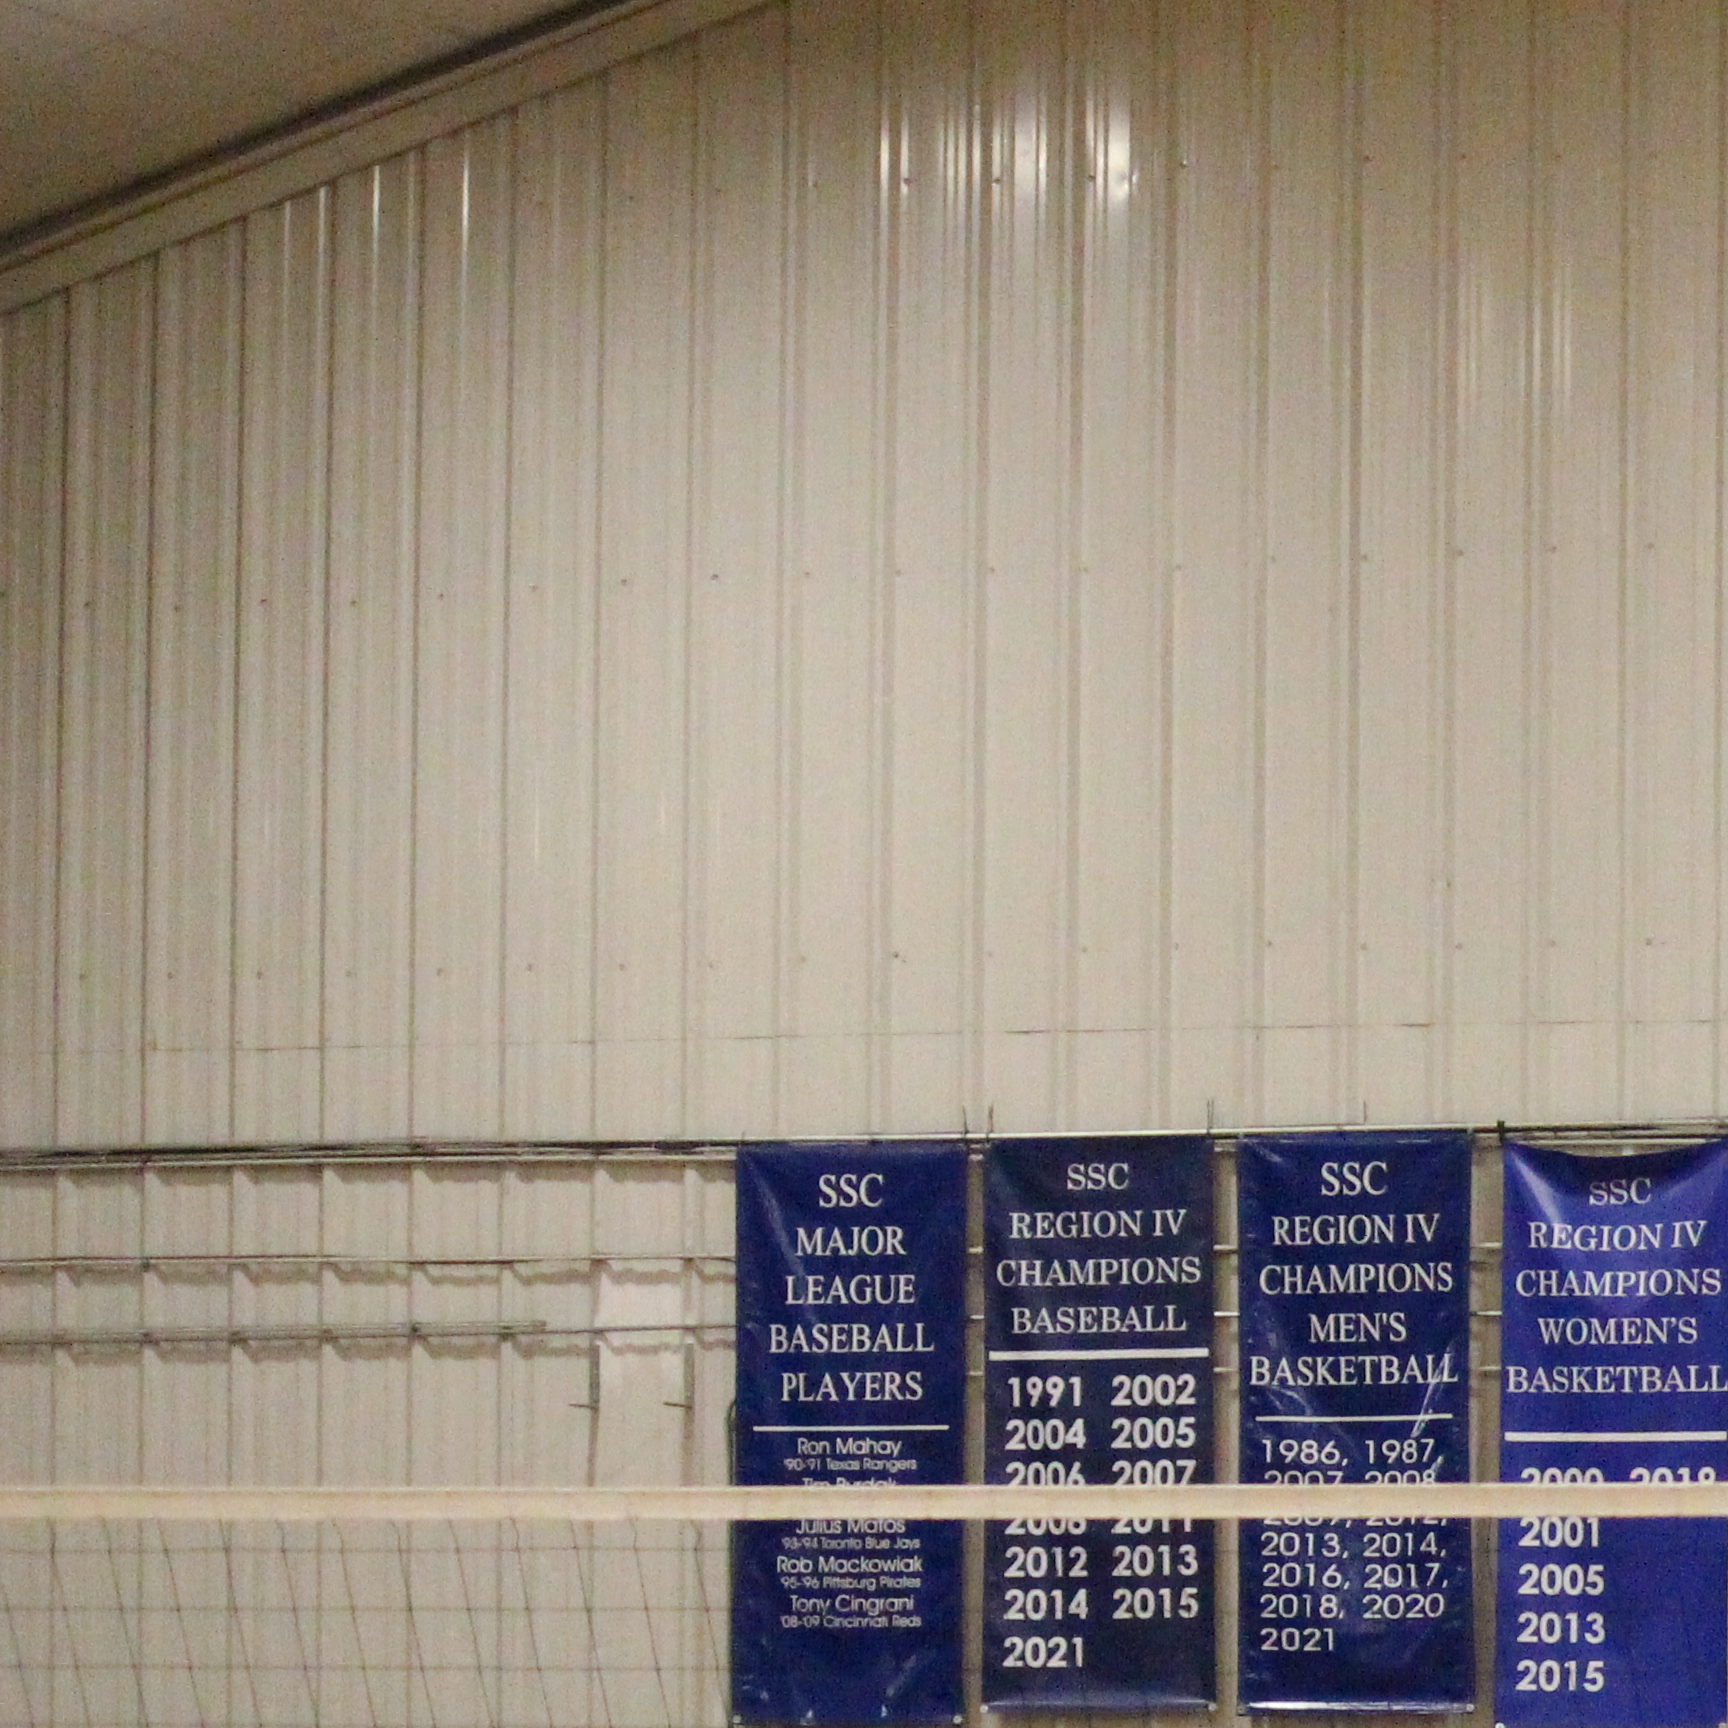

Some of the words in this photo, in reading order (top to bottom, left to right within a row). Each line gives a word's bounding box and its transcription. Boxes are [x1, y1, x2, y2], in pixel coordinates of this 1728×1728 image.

[818, 1174, 883, 1207] SSC
[1067, 1163, 1129, 1189] SSC
[1321, 1161, 1388, 1195] SSC
[1589, 1178, 1651, 1206] SSC
[1008, 1211, 1143, 1239] REGION
[1150, 1210, 1186, 1236] IV
[1272, 1215, 1394, 1245] REGION
[1404, 1213, 1439, 1242] IV
[1529, 1223, 1663, 1251] REGION
[1671, 1220, 1707, 1248] IV
[795, 1226, 906, 1256] MAJOR
[996, 1257, 1201, 1287] CHAMPIONS
[1259, 1262, 1452, 1295] CHAMPIONS
[1515, 1269, 1722, 1297] CHAMPIONS
[785, 1276, 916, 1305] LEAGUE
[1011, 1306, 1187, 1334] BASEBALL
[1309, 1313, 1407, 1342] MEN'S
[1538, 1317, 1697, 1345] WOMEN'S
[769, 1323, 934, 1354] BASEBALL
[1249, 1354, 1459, 1385] BASKETBALL
[1506, 1366, 1728, 1394] BASKETBALL
[781, 1372, 922, 1402] PLAYERS
[1008, 1376, 1081, 1407] 1991
[1111, 1374, 1196, 1406] 2002
[797, 1438, 830, 1454] Ron
[836, 1437, 902, 1457] Mahay
[1005, 1418, 1086, 1450] 2004
[1111, 1417, 1196, 1448] 2005
[826, 1458, 860, 1470] Texas
[863, 1458, 917, 1473] Rangers
[1262, 1439, 1348, 1466] 1986,
[1005, 1461, 1085, 1485] 2006
[1111, 1459, 1196, 1485] 2007
[796, 1520, 842, 1534] Julius
[847, 1520, 906, 1533] Matos
[1518, 1517, 1599, 1548] 2001
[1261, 1532, 1348, 1559] 2013,
[1363, 1532, 1446, 1557] 2014,
[777, 1556, 812, 1573] Rob
[818, 1556, 922, 1573] Mackowiak
[1004, 1546, 1088, 1578] 2012
[1111, 1544, 1198, 1576] 2013
[1263, 1563, 1350, 1590] 2016,
[1364, 1563, 1448, 1590] 2017,
[1517, 1564, 1605, 1596] 2005
[790, 1595, 830, 1615] Tony
[835, 1594, 914, 1615] Cingrani
[1004, 1588, 1088, 1620] 2014
[1112, 1587, 1198, 1619] 2015
[1260, 1594, 1345, 1619] 2018,
[1363, 1593, 1444, 1619] 2020
[1260, 1628, 1334, 1651] 2021
[1516, 1612, 1605, 1644] 2013
[1003, 1637, 1082, 1668] 2021
[1515, 1660, 1605, 1692] 2015
